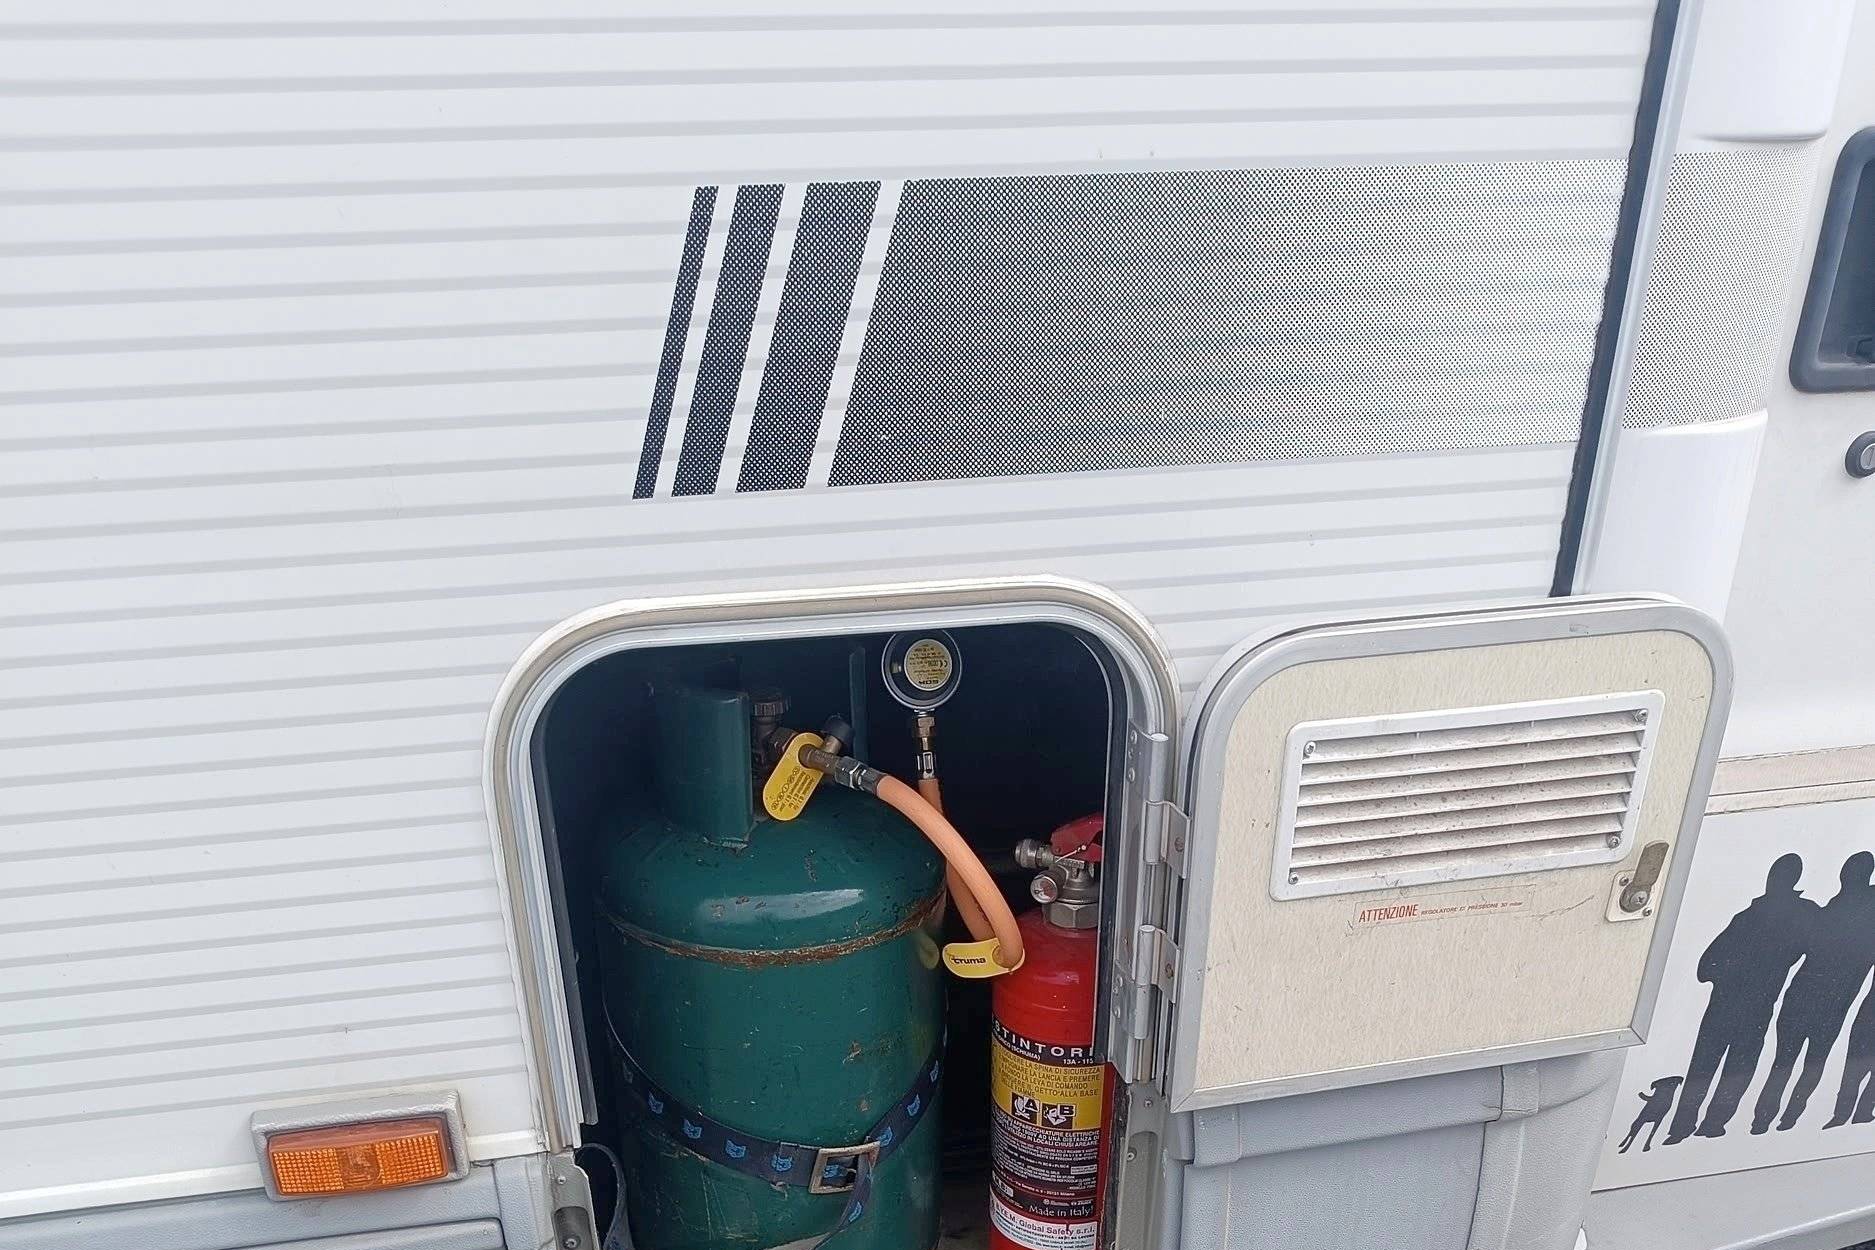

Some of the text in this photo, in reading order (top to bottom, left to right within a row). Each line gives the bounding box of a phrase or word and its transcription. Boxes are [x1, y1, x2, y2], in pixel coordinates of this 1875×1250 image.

[1358, 904, 1419, 923] ATTENZIONE
[993, 1016, 1094, 1057] STINTORI
[1038, 1071, 1060, 1081] LANCIA
[1069, 1074, 1100, 1082] PREMERE
[1063, 1067, 1100, 1075] SICUREZZA
[1055, 1082, 1088, 1090] COMANDO
[1060, 1089, 1078, 1097] ALLA
[1080, 1089, 1098, 1097] BASE
[1033, 1138, 1053, 1146] LOCALI
[1029, 1205, 1091, 1218] Made in Italy
[1019, 1219, 1045, 1232] Global
[1046, 1226, 1074, 1236] Safety
